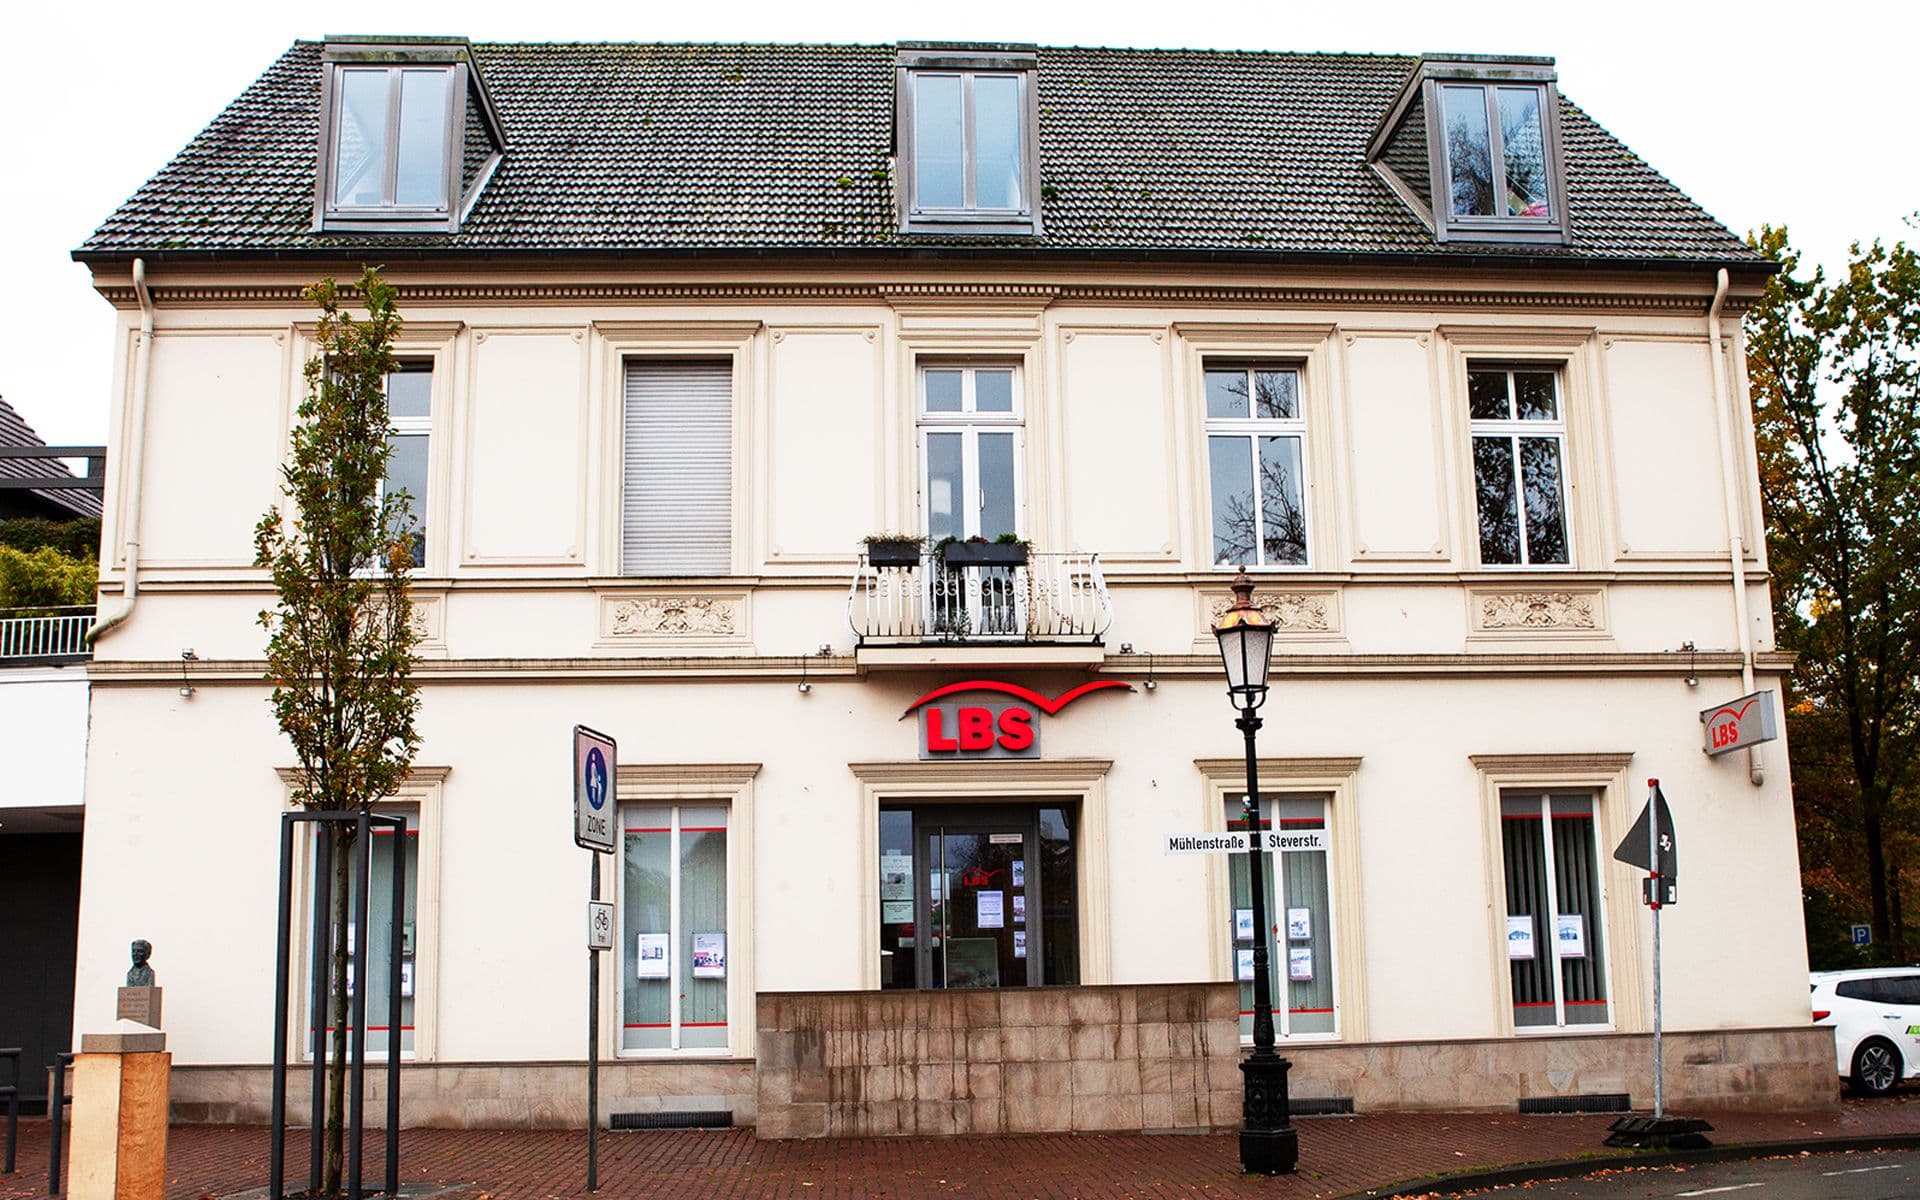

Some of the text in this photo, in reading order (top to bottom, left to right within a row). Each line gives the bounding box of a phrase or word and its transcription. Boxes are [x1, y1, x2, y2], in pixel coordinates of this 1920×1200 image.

[926, 706, 1035, 752] LBS
[1712, 721, 1738, 748] LBS
[587, 815, 606, 836] ZONE
[1169, 836, 1245, 850] Mühlenstraße
[1269, 834, 1322, 847] Steverstr.
[963, 876, 989, 886] LBS
[1856, 928, 1866, 942] P
